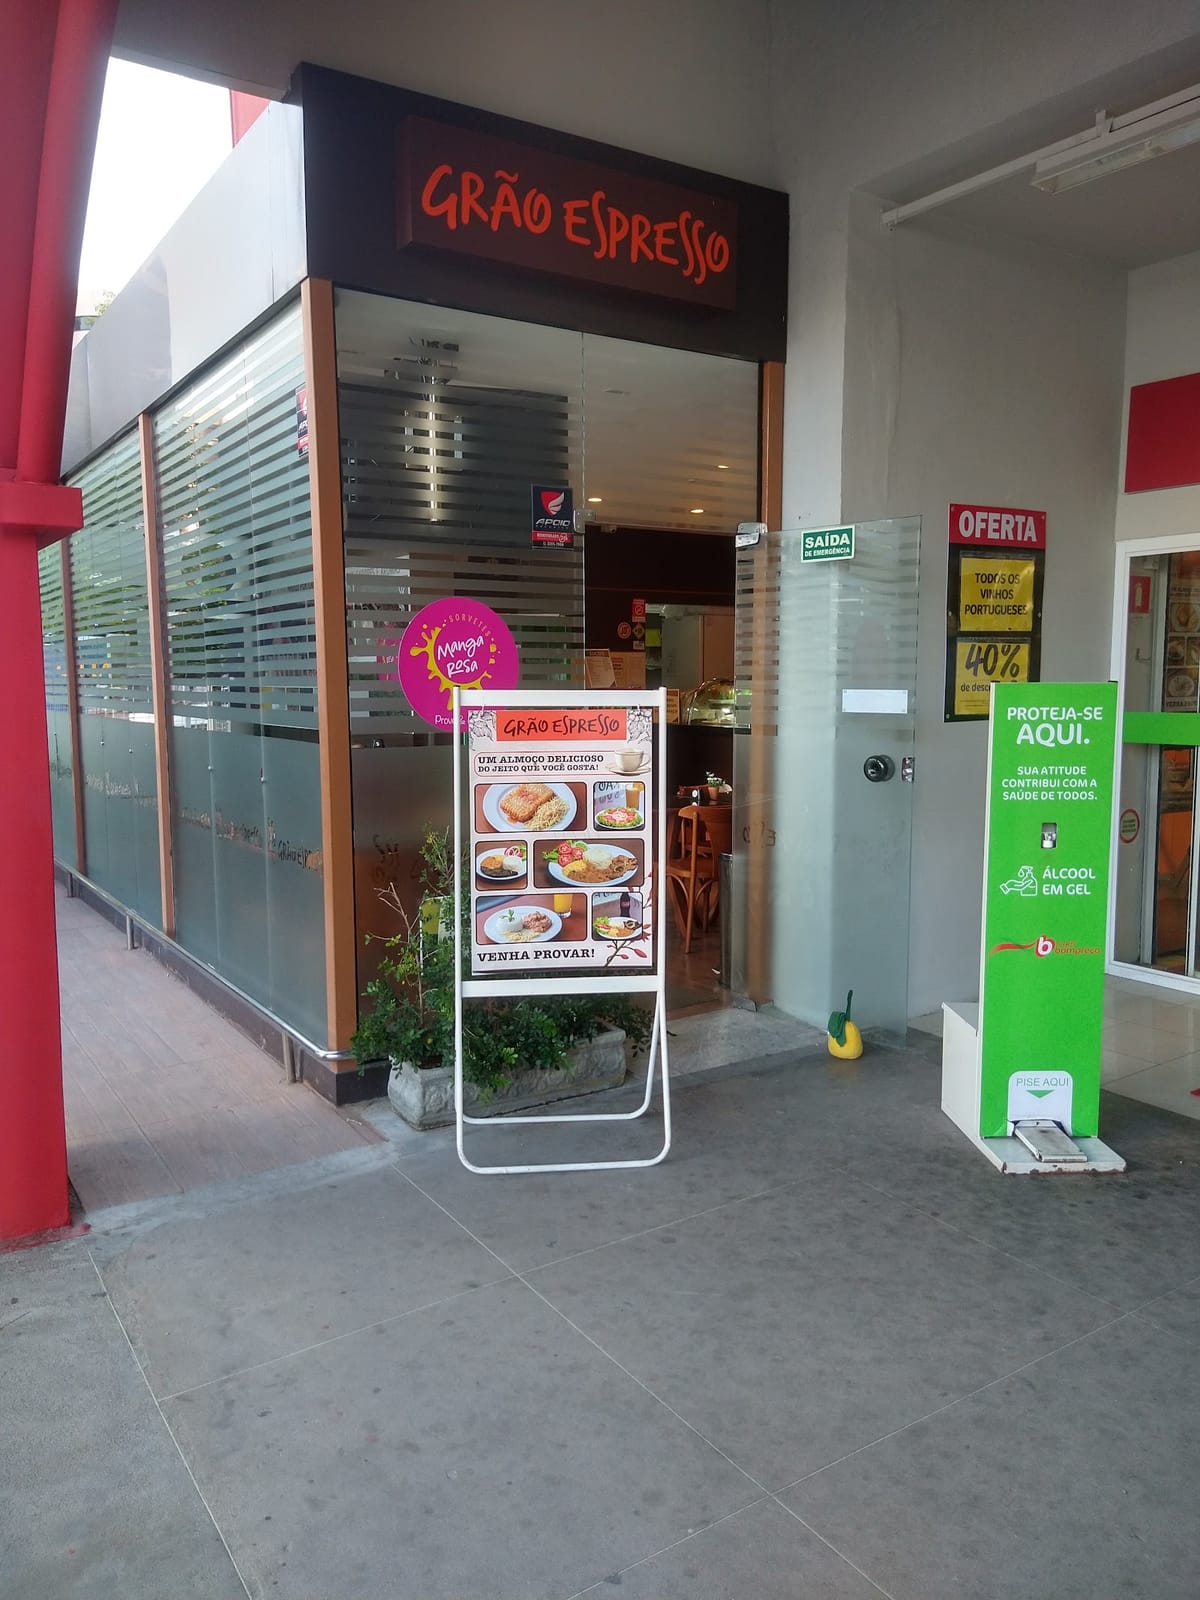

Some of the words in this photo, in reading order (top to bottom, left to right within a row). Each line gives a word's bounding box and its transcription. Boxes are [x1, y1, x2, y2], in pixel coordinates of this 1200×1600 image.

[421, 164, 552, 234] GRÃO
[563, 190, 729, 284] ESPRESSO
[535, 518, 571, 527] APOIO
[958, 510, 1038, 543] OFERTA
[804, 532, 851, 549] SAÍDA
[804, 550, 813, 558] DE
[813, 546, 850, 557] EMERGÊNCIA
[975, 572, 1006, 585] TODOS
[1007, 573, 1021, 585] OS
[979, 588, 1015, 600] VINHOS
[964, 603, 1029, 616] PORTUGUESES
[447, 613, 492, 637] SORVETES
[436, 634, 485, 661] Manga
[964, 643, 1021, 679] 40%
[960, 682, 971, 693] de
[434, 713, 454, 726] Prov
[1007, 706, 1104, 721] PROTEJA-SE
[503, 717, 548, 737] GRÃO
[552, 713, 620, 737] ESPRESSO
[1016, 723, 1091, 747] AQUI.
[478, 756, 497, 765] UM
[499, 755, 545, 766] ALMOÇO
[546, 754, 604, 764] DELICIOSO
[478, 765, 490, 773] DO
[491, 765, 520, 773] JEITO
[520, 764, 540, 772] QUE
[541, 762, 566, 772] VOCÊ
[566, 763, 600, 772] GOSTA!
[1017, 766, 1040, 775] SUA
[1040, 766, 1088, 775] ATITUDE
[1001, 778, 1060, 788] CONTRIBUI
[1062, 778, 1088, 788] COM
[1089, 778, 1098, 788] A
[1002, 789, 1039, 800] SAÚDE
[1040, 791, 1055, 800] DE
[1056, 790, 1099, 801] TODOS.
[1042, 865, 1096, 880] ÁLCOOL
[1042, 883, 1063, 896] EM
[1065, 883, 1092, 896] GEL
[477, 950, 531, 962] VENHA
[533, 948, 596, 961] PROVAR!
[1016, 1077, 1041, 1088] PISE
[1042, 1077, 1070, 1088] AQUI
